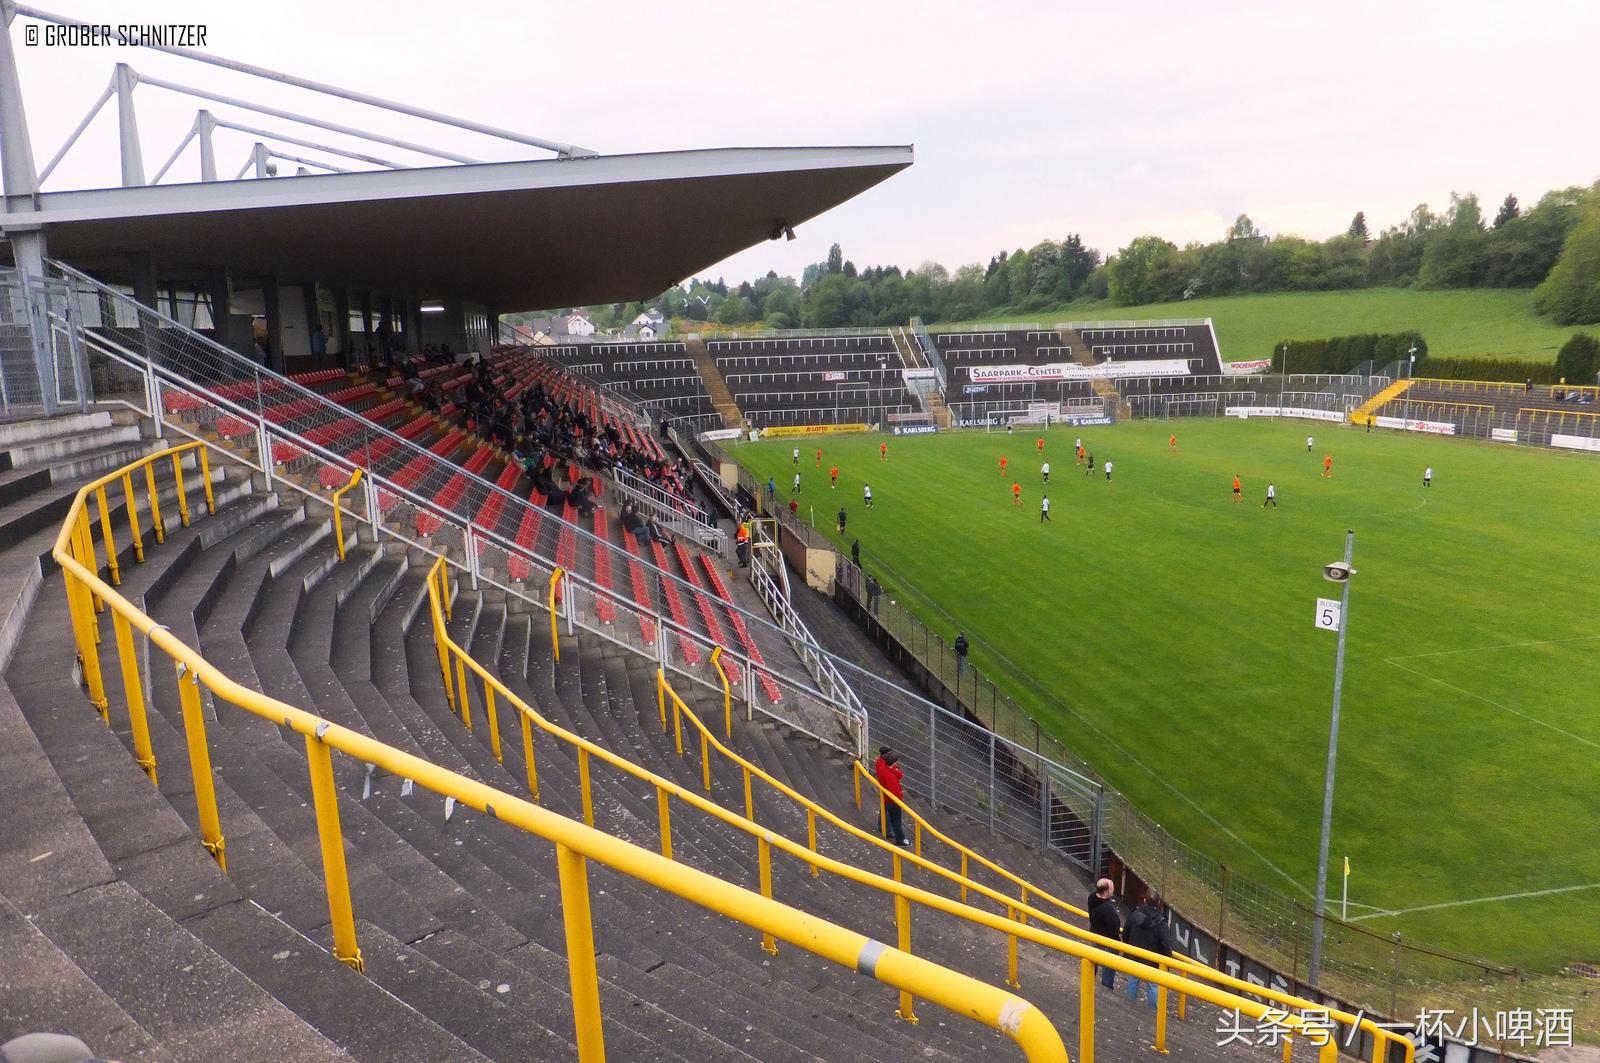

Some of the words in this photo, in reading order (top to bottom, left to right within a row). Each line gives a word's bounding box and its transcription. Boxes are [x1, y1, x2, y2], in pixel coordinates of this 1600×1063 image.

[960, 417, 999, 427] KARLSBERG
[903, 425, 936, 434] KARLSBERG
[1322, 609, 1333, 626] 5
